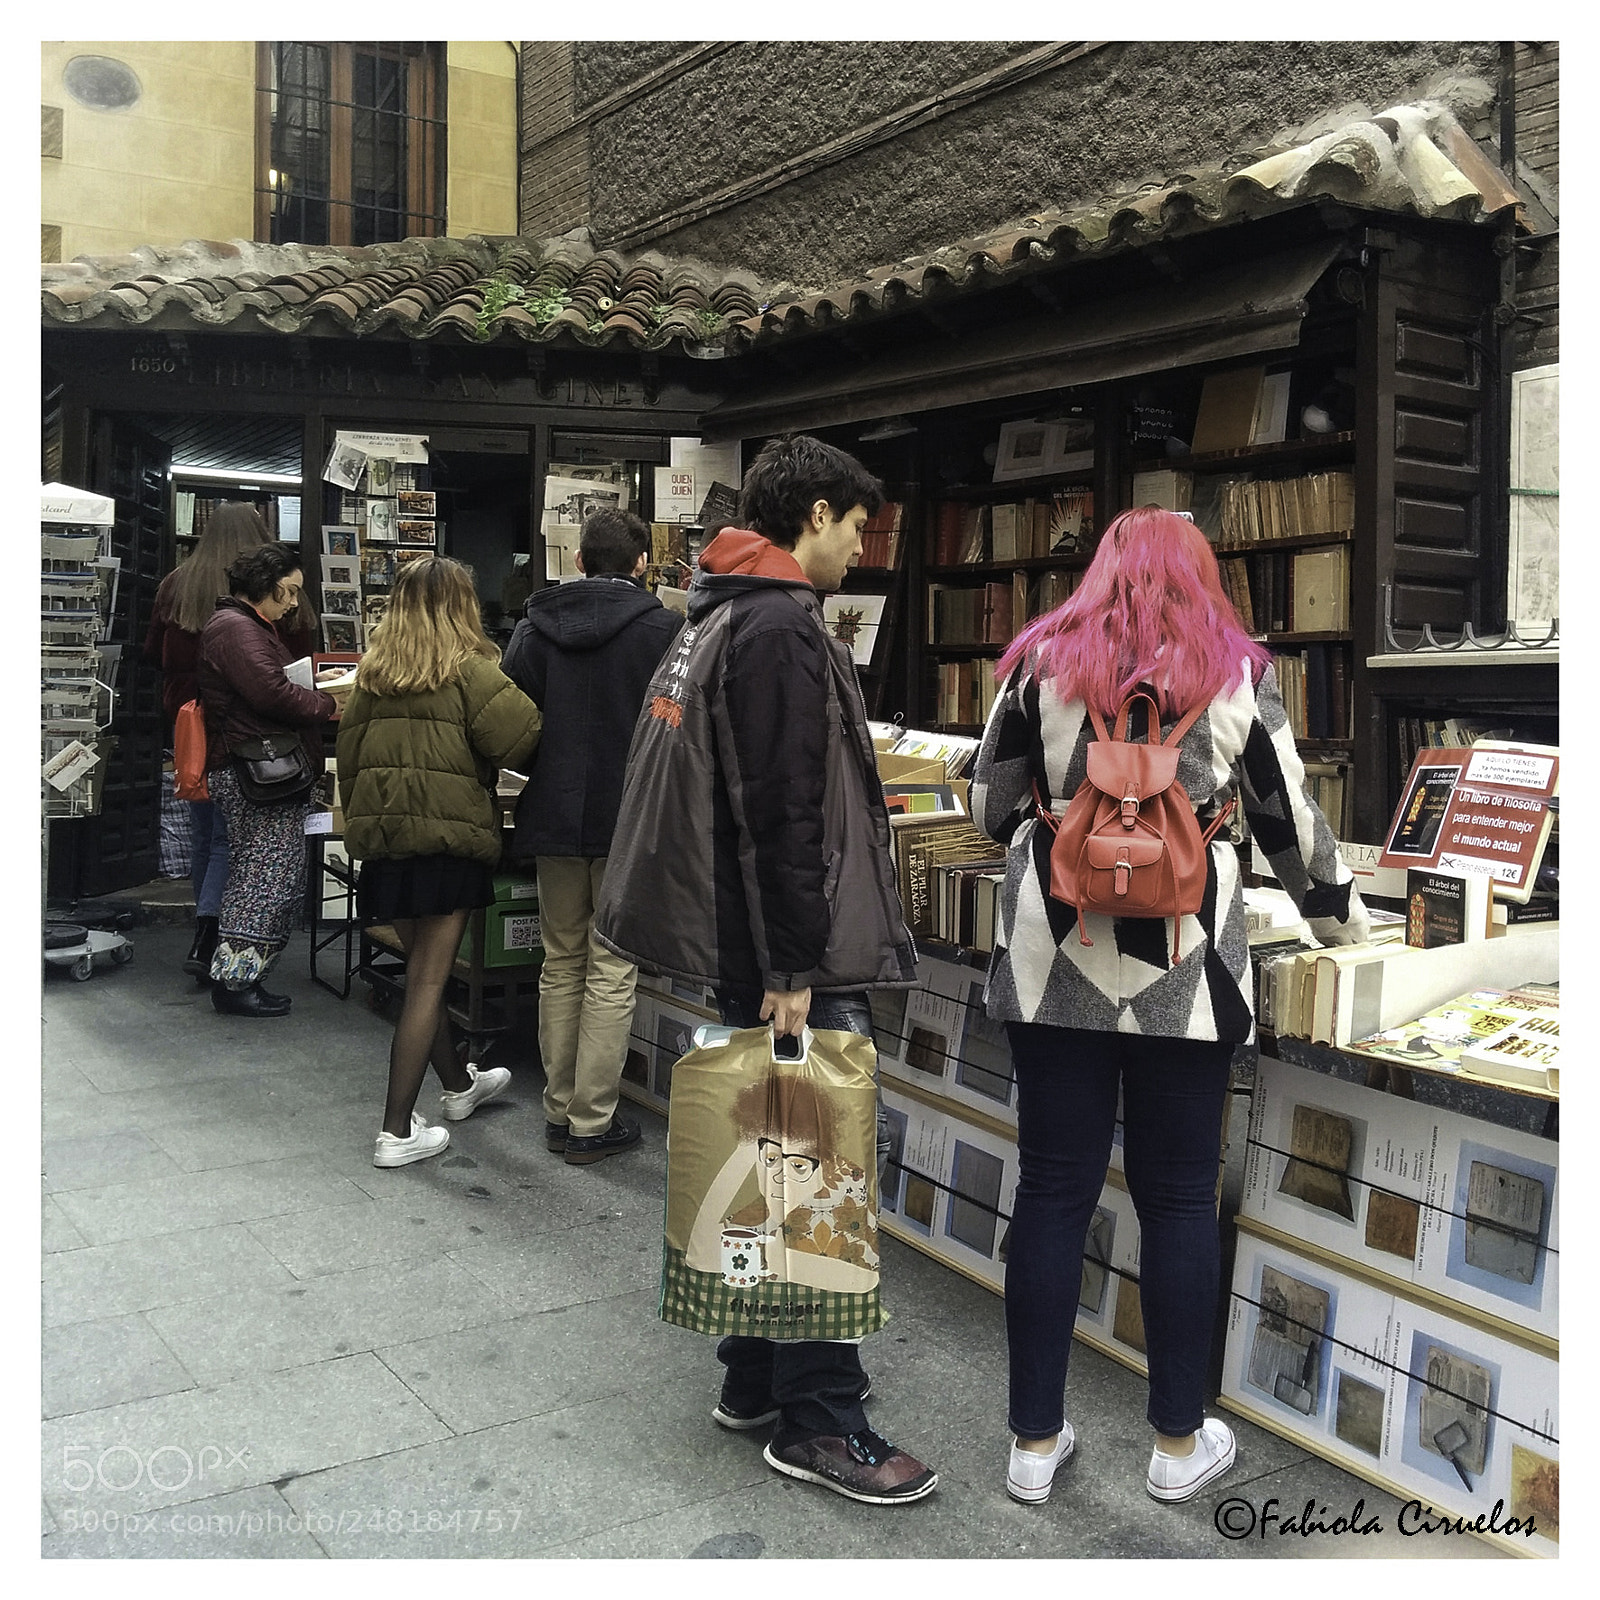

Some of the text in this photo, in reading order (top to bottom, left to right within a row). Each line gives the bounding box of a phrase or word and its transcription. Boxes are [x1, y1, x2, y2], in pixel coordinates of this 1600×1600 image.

[130, 357, 175, 372] 1650
[672, 474, 692, 484] QUIEN
[672, 486, 692, 496] QUIEN
[1458, 791, 1470, 802] Un
[1470, 792, 1490, 804] libro
[1491, 795, 1502, 806] de
[1452, 813, 1536, 834] para entender mejor
[1452, 832, 1522, 853] el mundo actual
[1502, 868, 1518, 879] 12€
[918, 858, 927, 906] EL PILAR
[1435, 880, 1450, 889] árbol
[1450, 883, 1460, 891] del
[909, 854, 921, 926] DE ZARAGOZA
[1422, 886, 1460, 899] conocimiento
[730, 1298, 823, 1318] flying tiger
